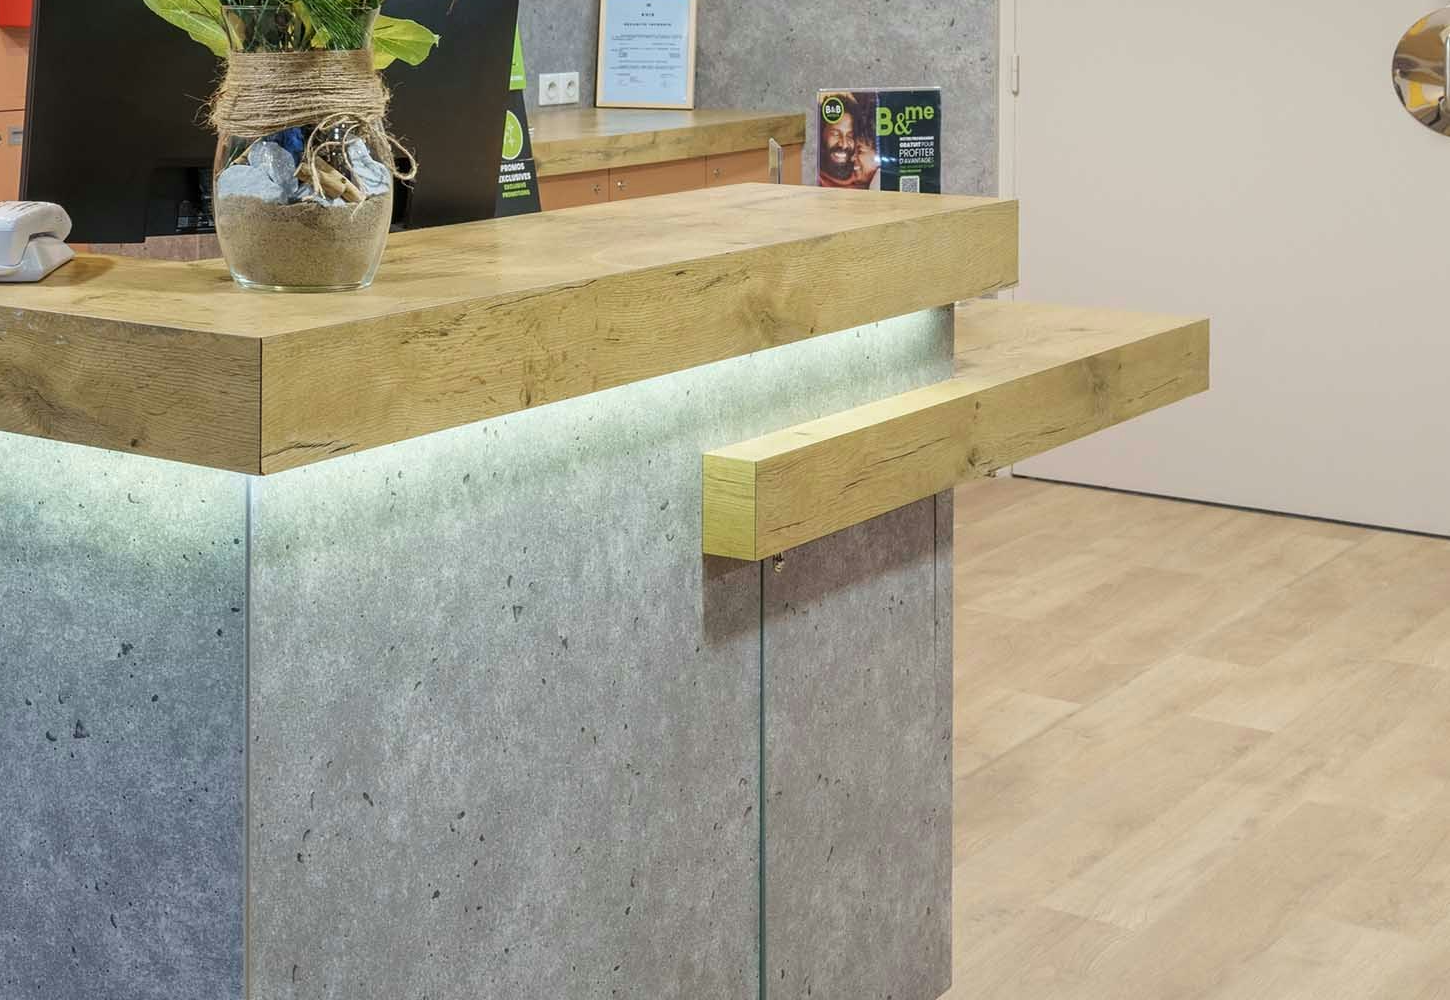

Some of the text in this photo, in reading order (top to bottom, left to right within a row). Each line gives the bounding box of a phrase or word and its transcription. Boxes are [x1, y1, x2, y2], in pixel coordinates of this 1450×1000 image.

[825, 105, 841, 113] B&B
[899, 148, 934, 157] PROFITER
[500, 163, 525, 172] PROMOS
